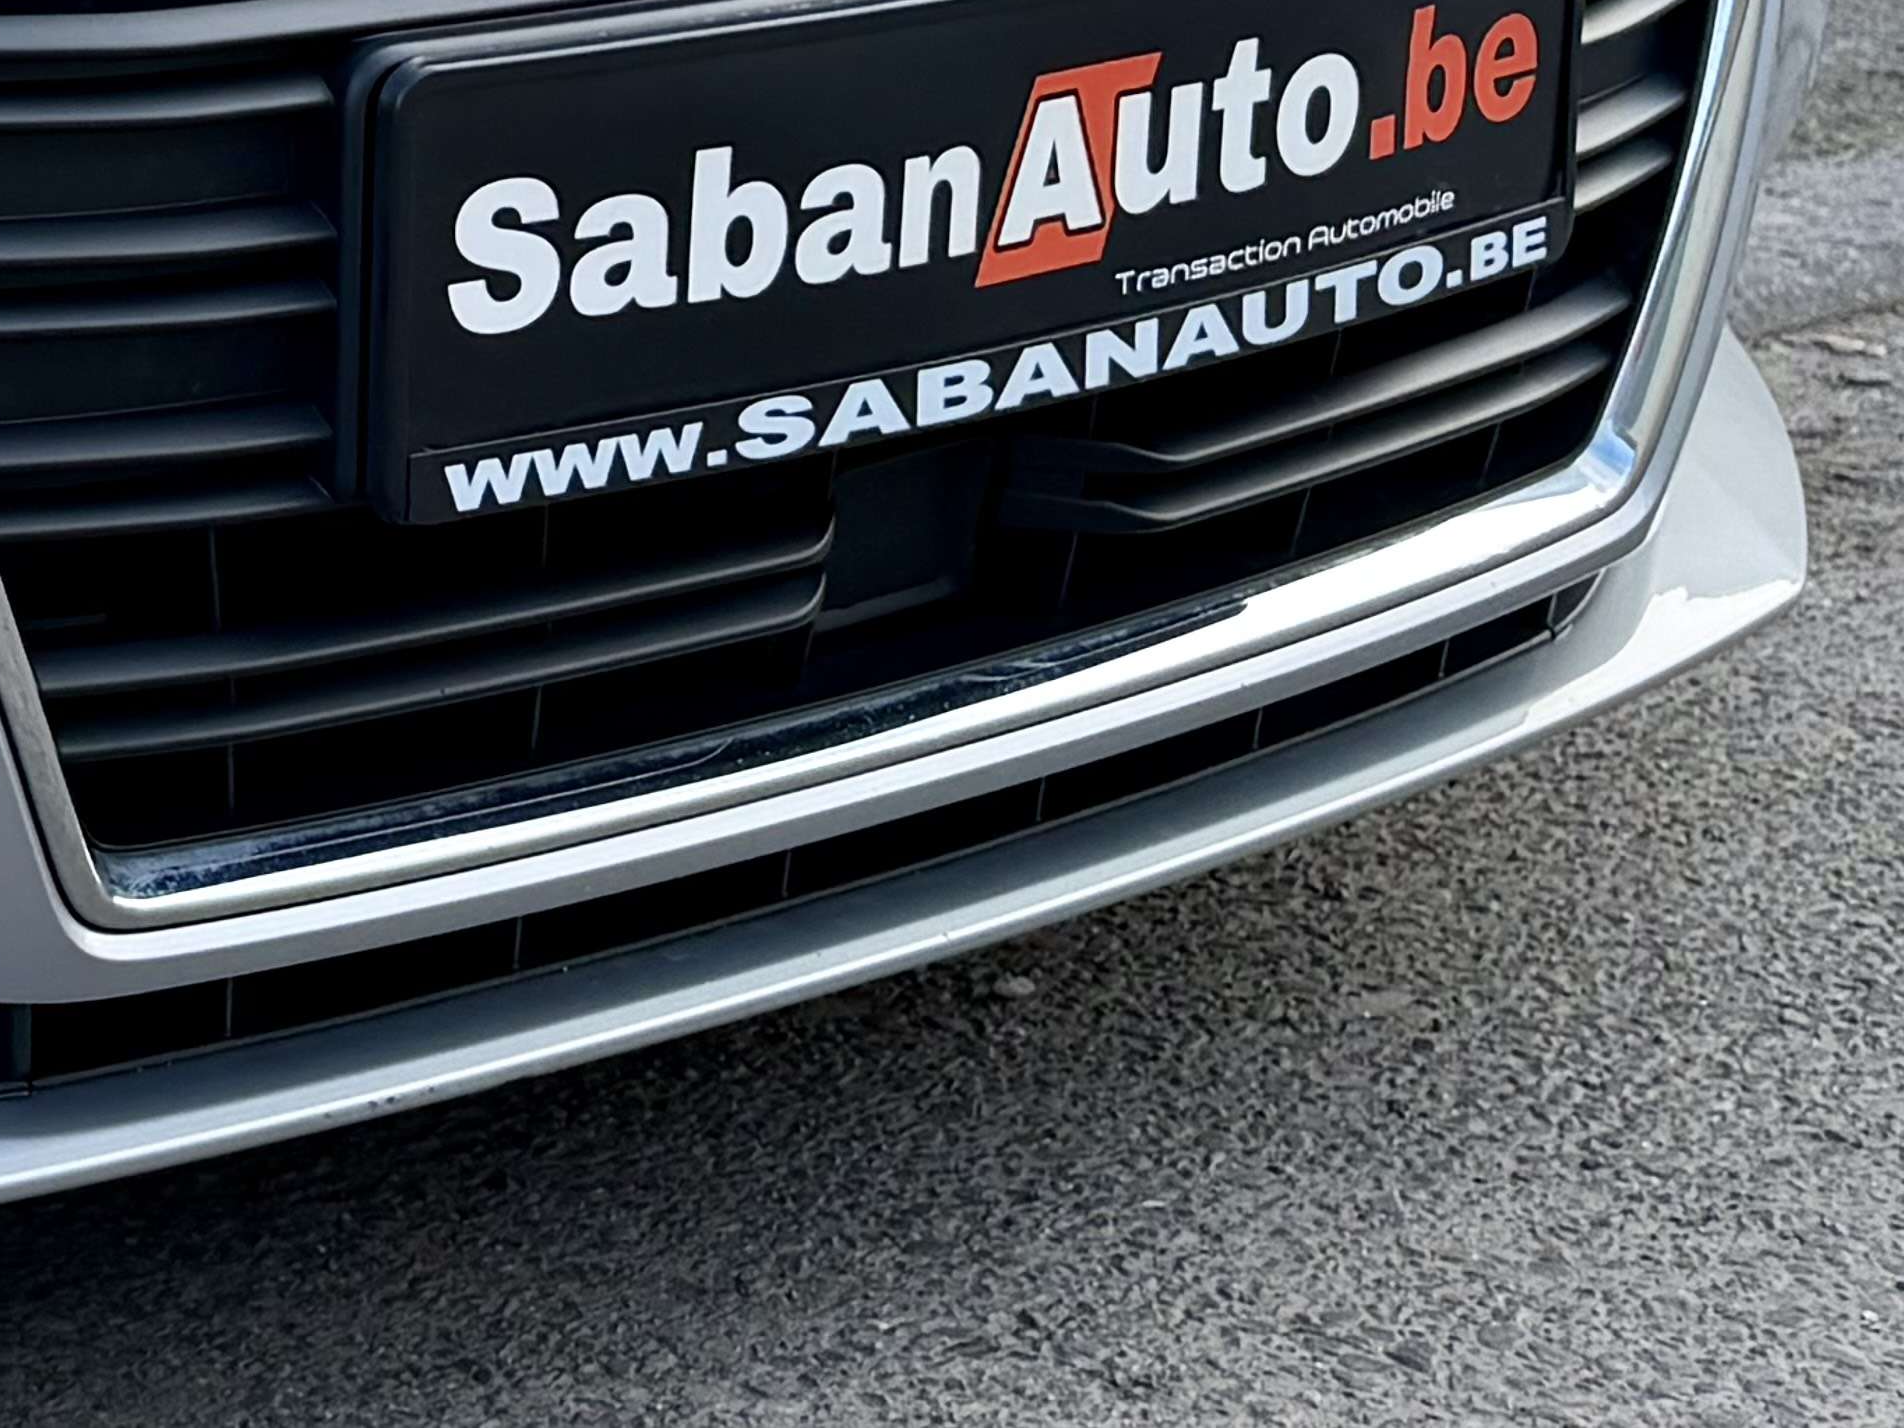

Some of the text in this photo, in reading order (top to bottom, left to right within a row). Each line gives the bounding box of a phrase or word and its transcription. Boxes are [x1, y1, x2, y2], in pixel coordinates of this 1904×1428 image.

[446, 4, 1540, 336] SabanAuto.be
[1114, 189, 1455, 297] Transaction Automobile
